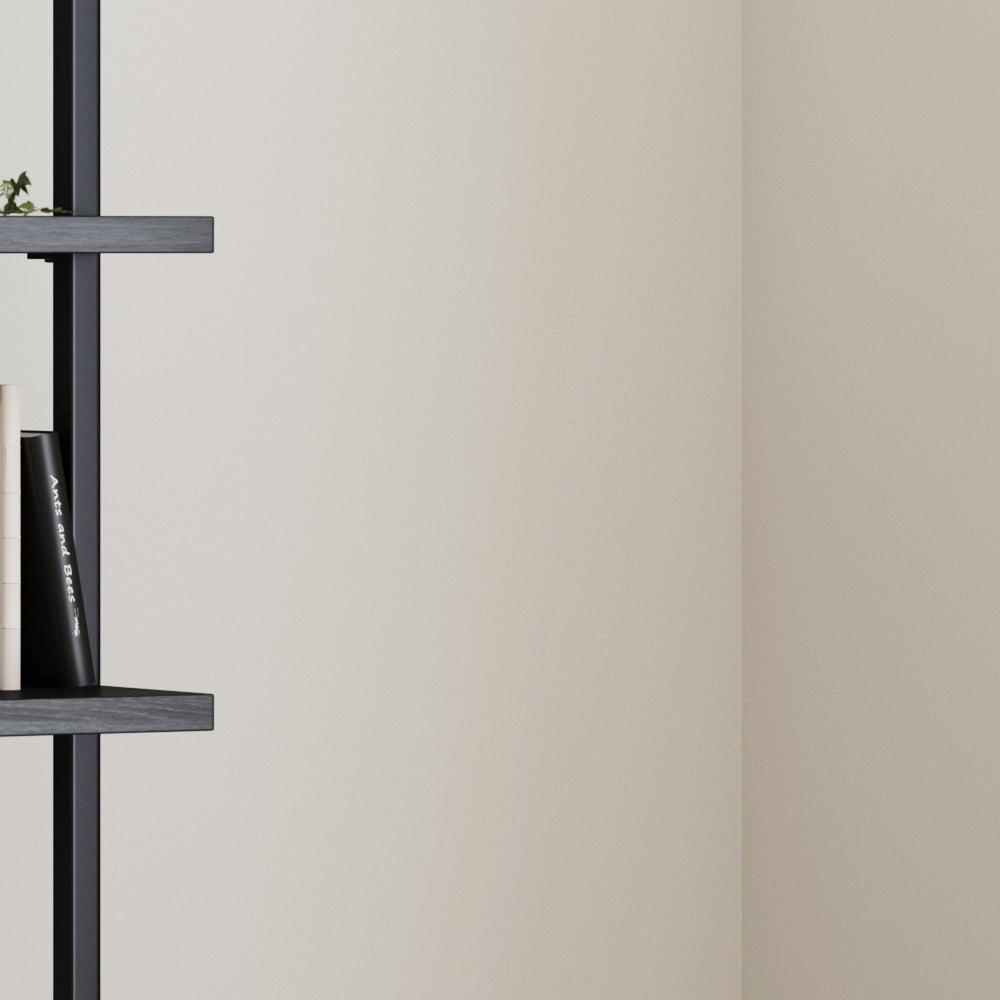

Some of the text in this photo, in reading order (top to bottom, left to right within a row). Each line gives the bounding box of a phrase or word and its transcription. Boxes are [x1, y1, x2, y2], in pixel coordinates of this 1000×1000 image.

[49, 474, 76, 603] Ants and Bees
